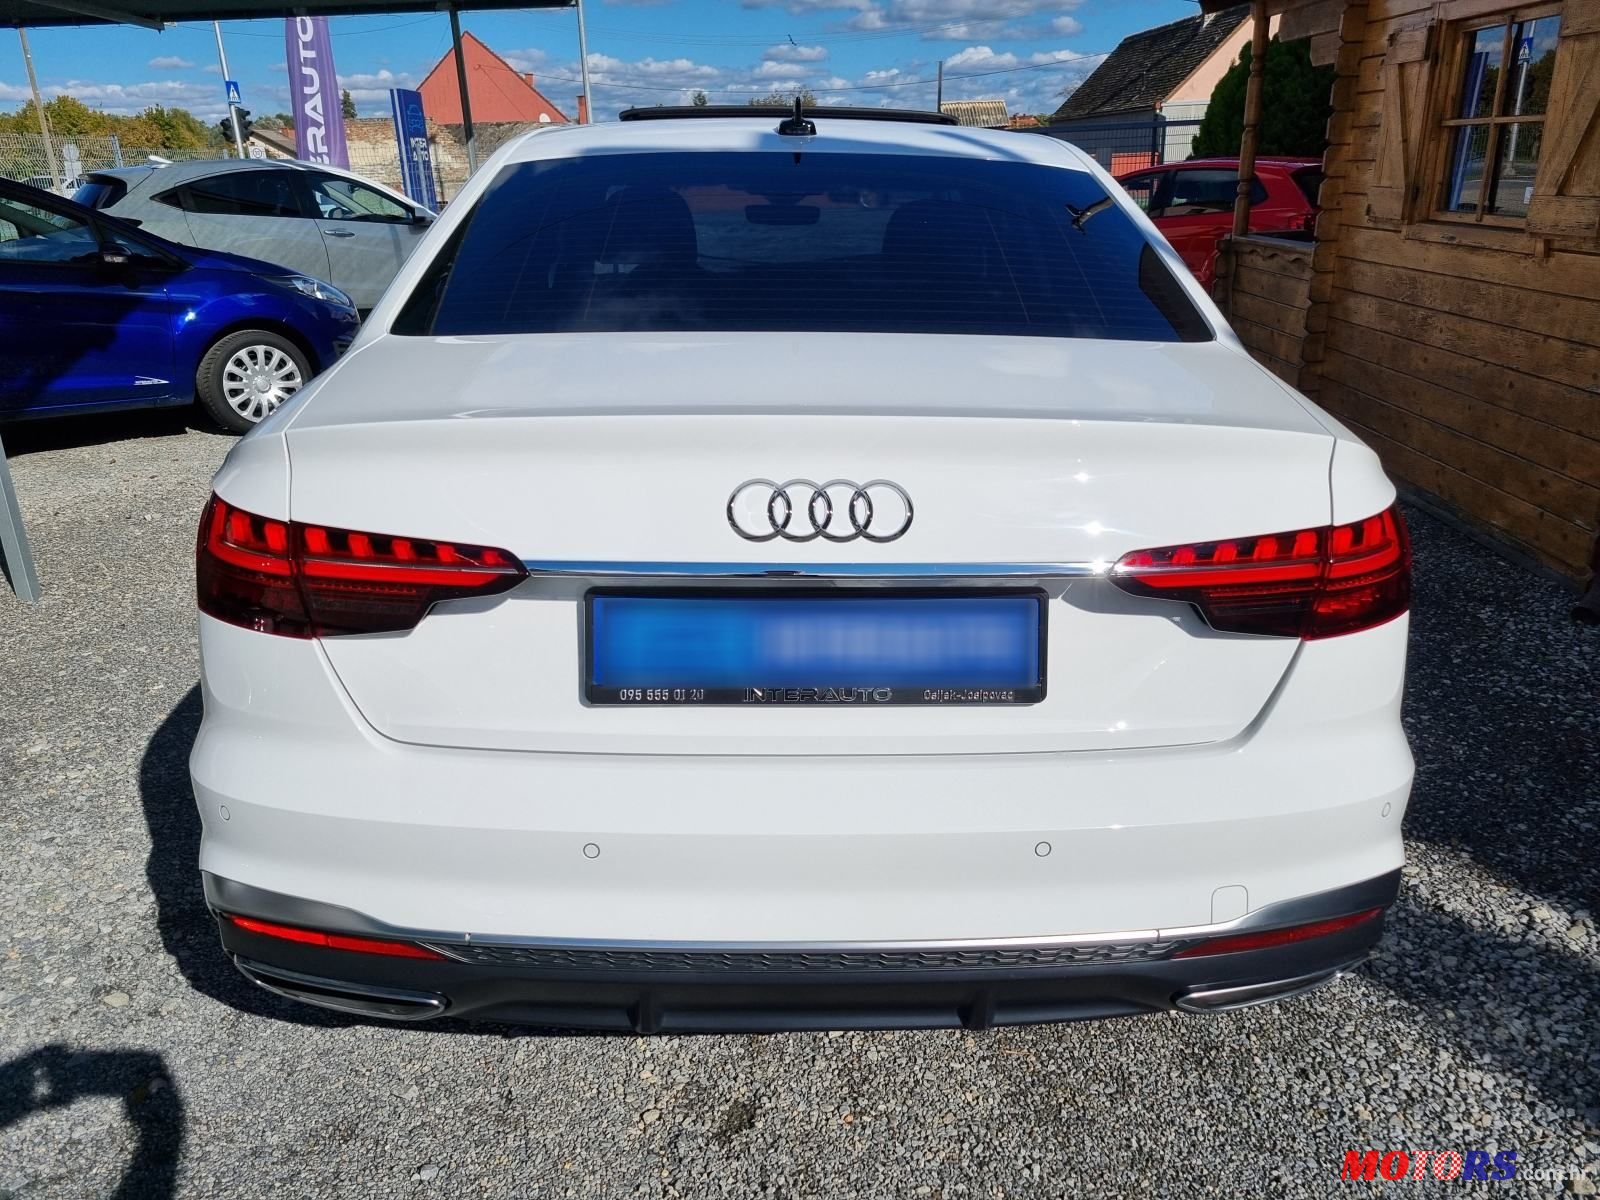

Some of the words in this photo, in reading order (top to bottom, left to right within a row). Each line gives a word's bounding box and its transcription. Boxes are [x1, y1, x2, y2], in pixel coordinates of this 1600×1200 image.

[620, 689, 642, 701] 095
[646, 689, 669, 701] 555
[743, 687, 893, 702] INTERAUTO
